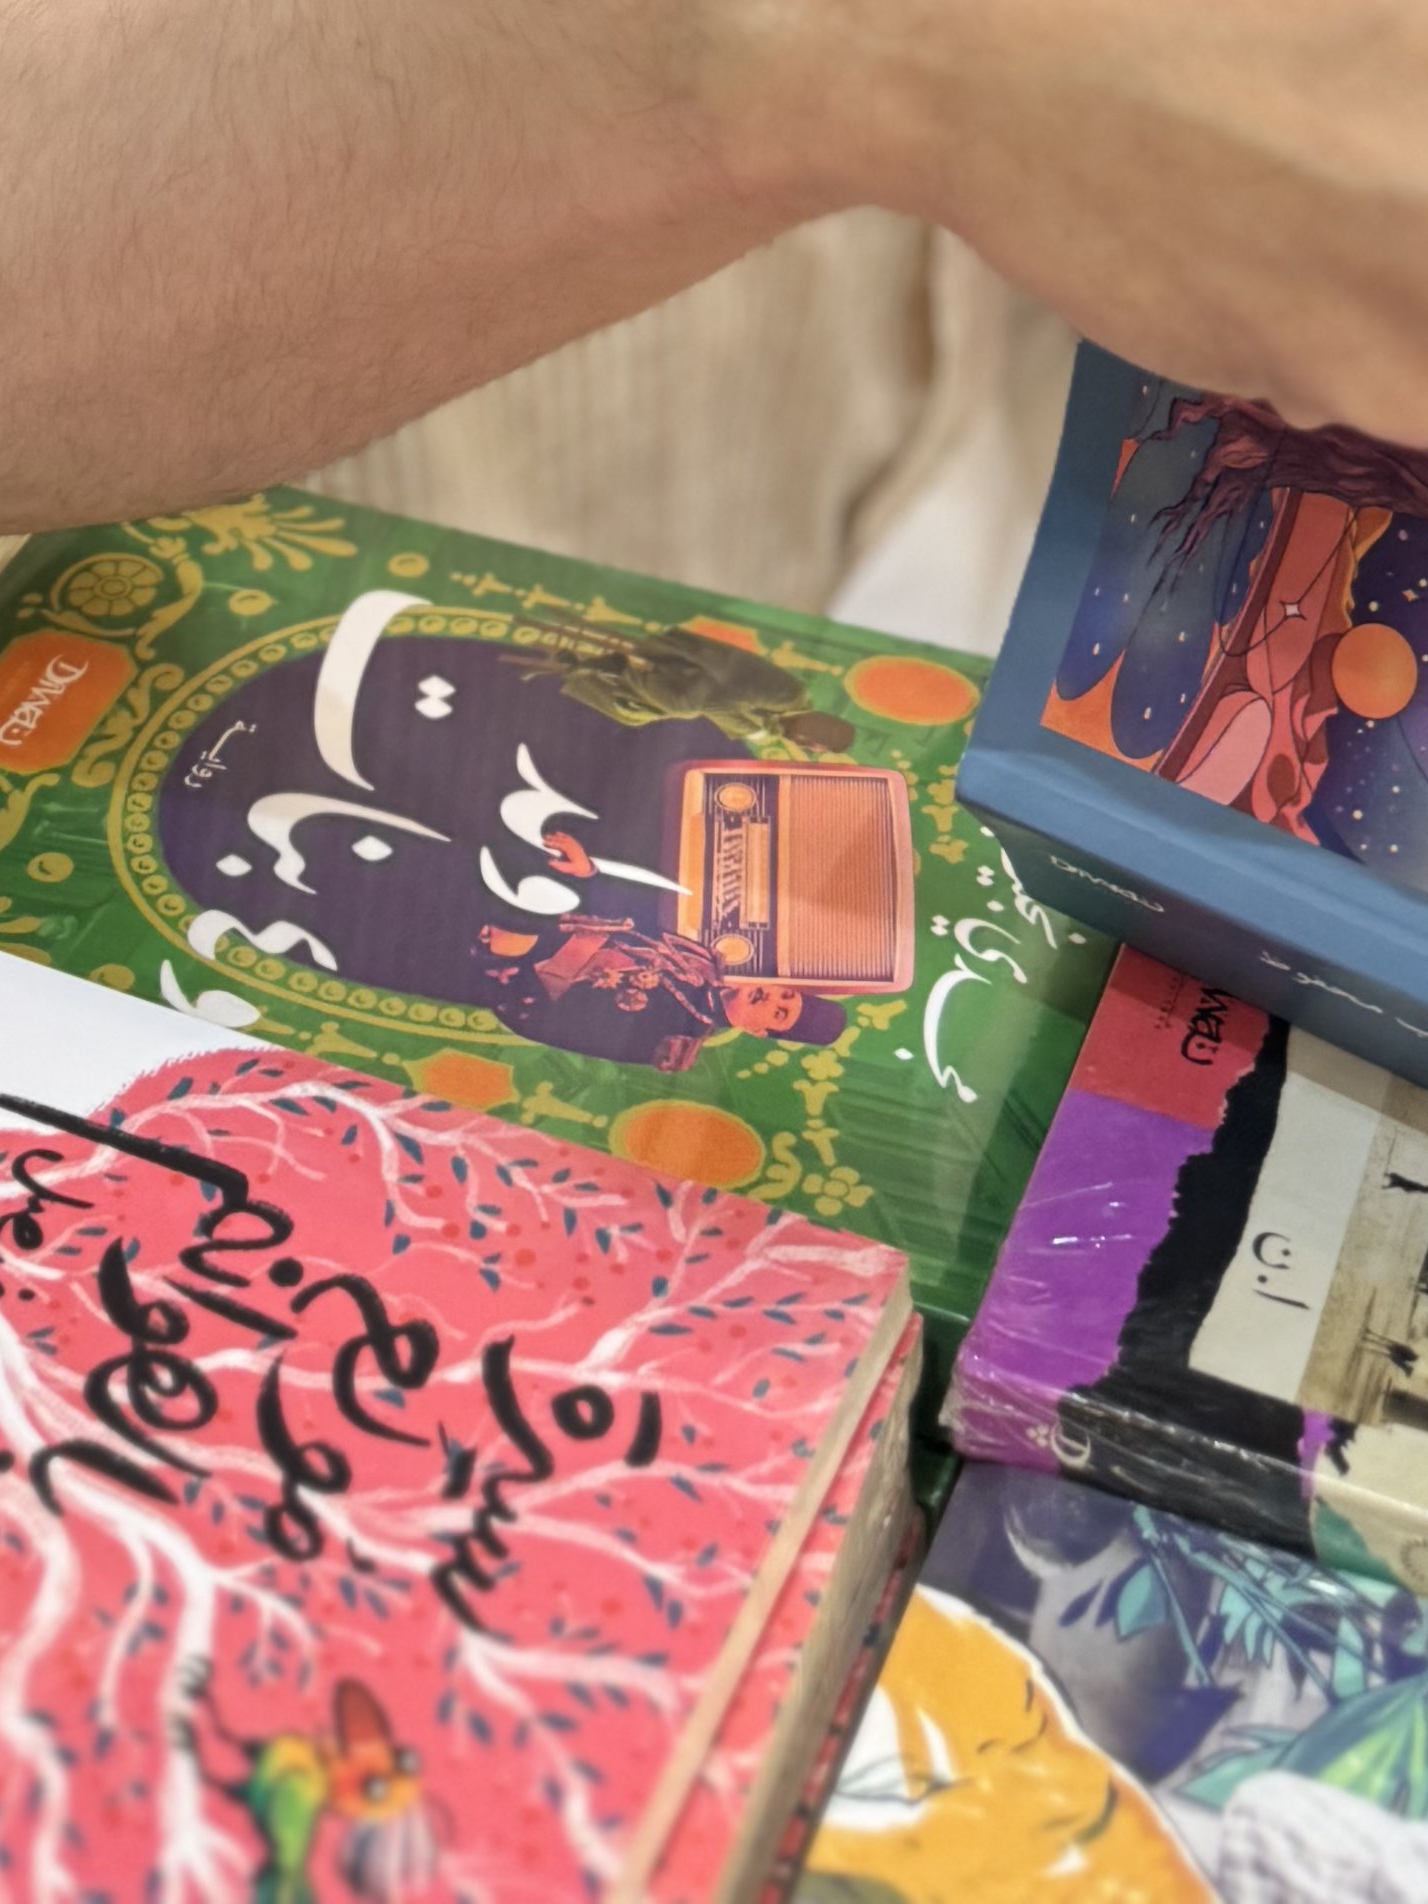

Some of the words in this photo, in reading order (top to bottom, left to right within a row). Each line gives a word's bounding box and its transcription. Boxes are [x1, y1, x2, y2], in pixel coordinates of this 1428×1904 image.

[183, 720, 256, 788] رواية
[214, 589, 457, 896] بنات
[479, 743, 692, 916] ولد
[893, 913, 1029, 1104] مجدي
[429, 1334, 663, 1638] سيرة
